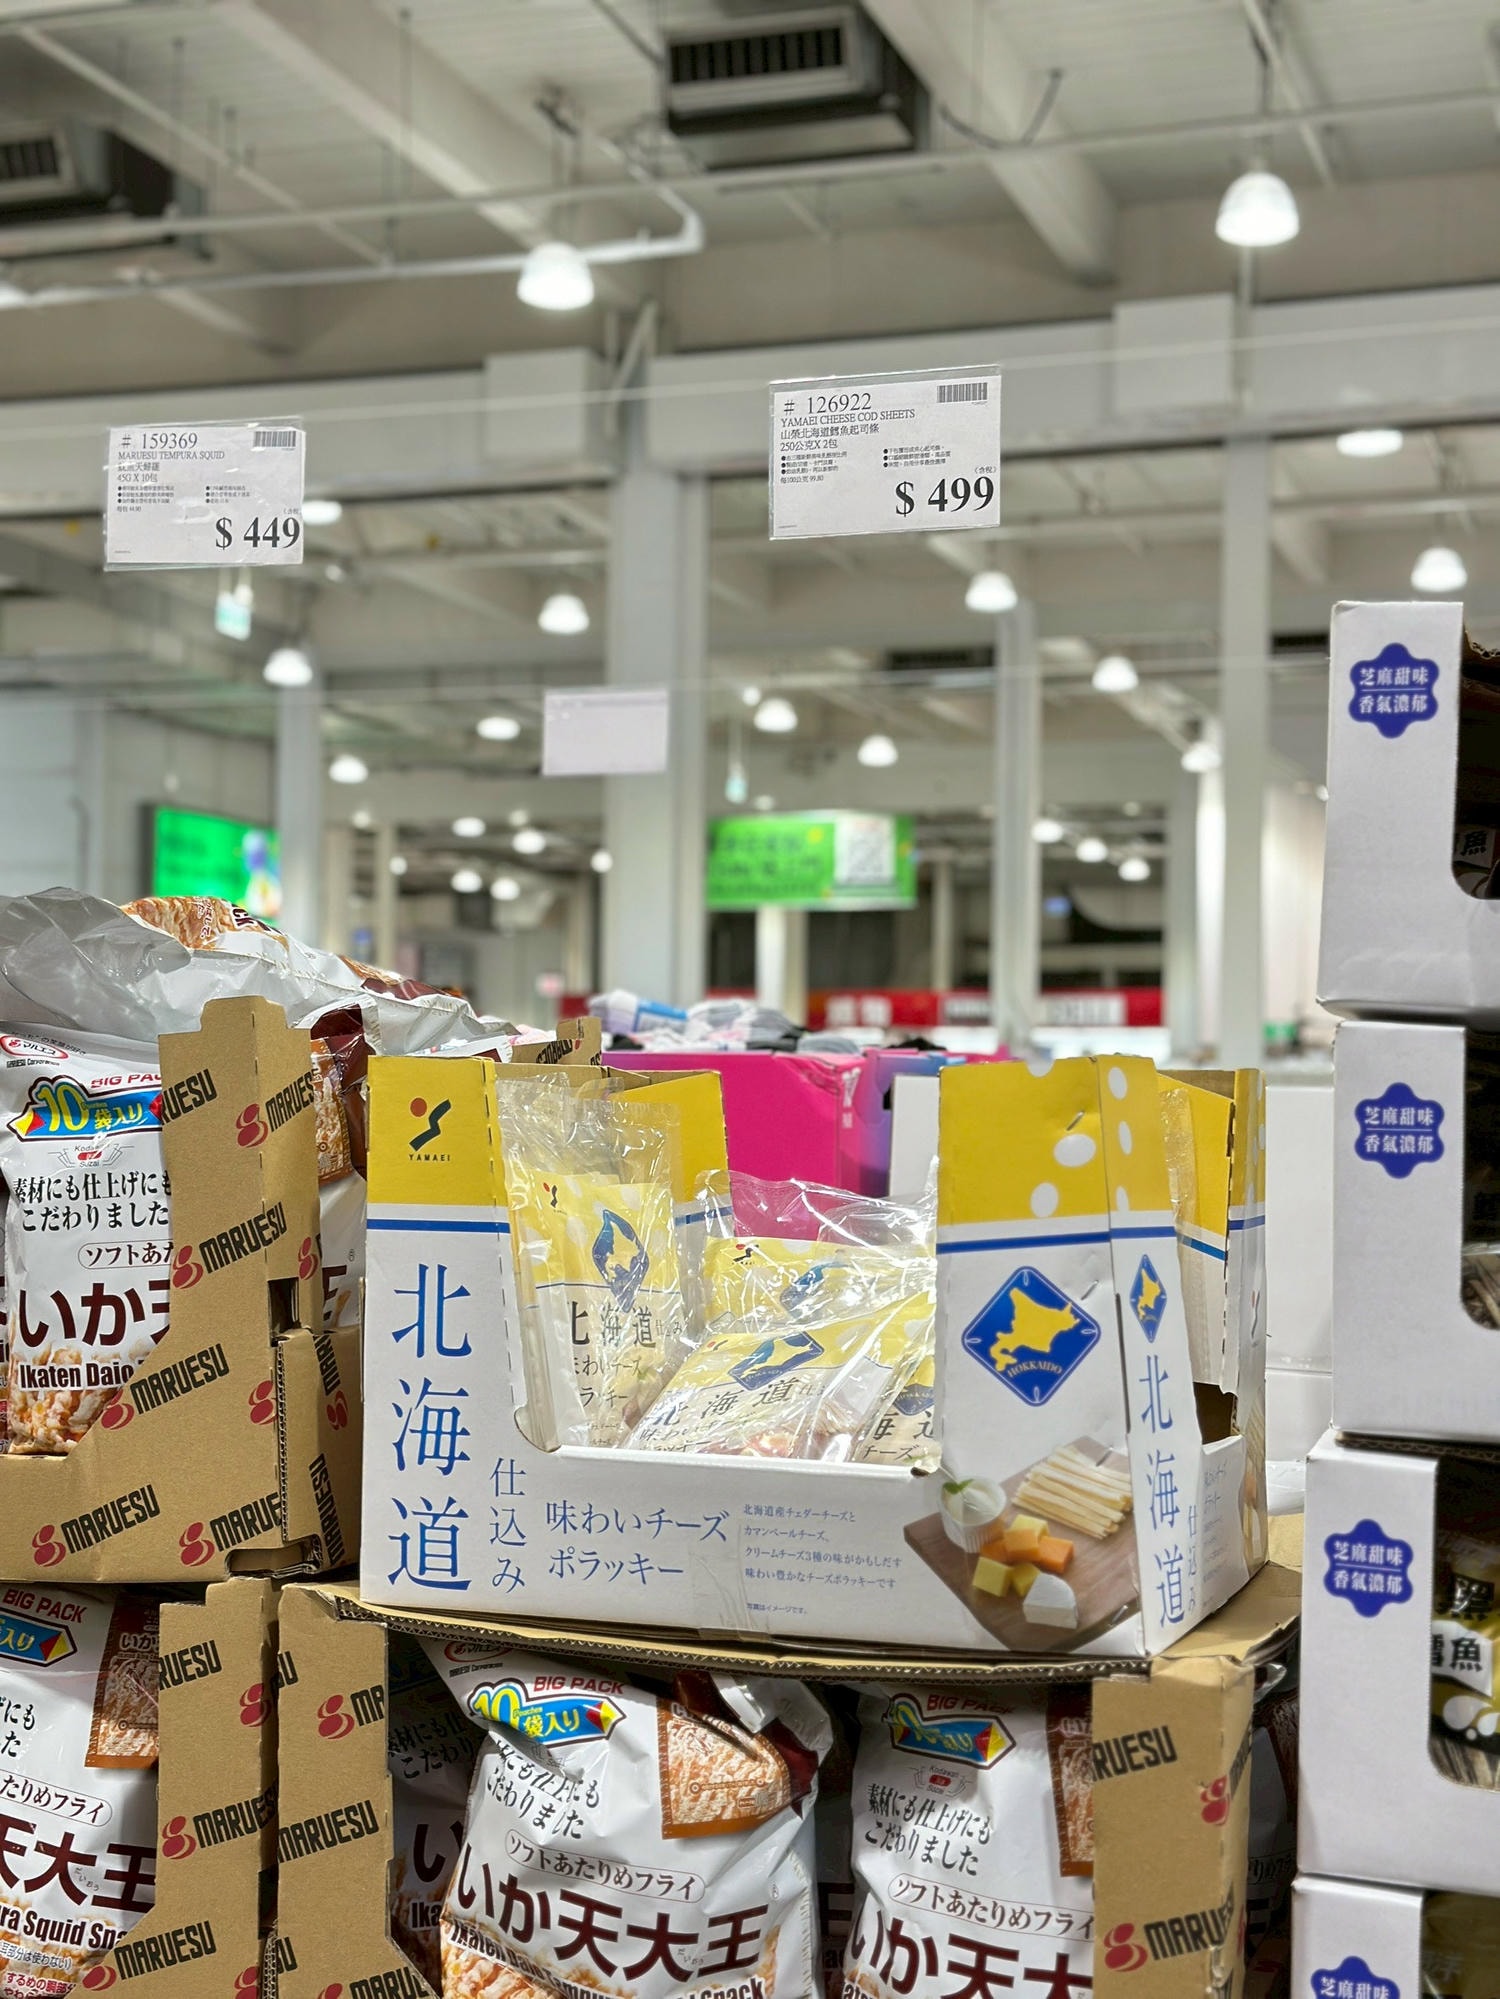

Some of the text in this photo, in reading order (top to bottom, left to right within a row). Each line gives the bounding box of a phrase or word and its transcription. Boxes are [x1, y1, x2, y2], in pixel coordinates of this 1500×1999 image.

[781, 409, 915, 428] YAMAEI CHEESE COD SHEETS
[807, 392, 872, 414] 126922
[118, 451, 225, 461] MARUESU TEMPURA SQUID
[142, 432, 198, 450] 159369
[895, 476, 994, 518] $ 499
[215, 517, 301, 550] $ 449
[1360, 667, 1429, 686] 芝麻甜味
[1359, 694, 1428, 714] 香氣濃郁
[91, 1076, 122, 1089] BIG
[36, 1083, 89, 1131] 10
[1365, 1107, 1434, 1126] 芝麻甜味
[409, 1154, 451, 1162] YAMAEI
[1364, 1135, 1433, 1154] 香氣濃郁
[22, 1202, 169, 1233] こだわりました
[199, 1201, 288, 1274] MARUESU
[20, 1362, 133, 1390] Ikaten Daio
[129, 1343, 230, 1415] MARUESU
[1007, 1360, 1063, 1378] HOKKAIDO
[391, 1264, 472, 1591] 北海道
[1139, 1355, 1185, 1627] 北海道
[61, 1484, 161, 1554] MARUESU
[489, 1458, 527, 1593] 仕込み
[546, 1499, 730, 1542] 味わいチーズ
[744, 1504, 856, 1522] 北海道産チェダーチーズと
[549, 1546, 683, 1585] ポラッキー
[1333, 1540, 1403, 1566] 芝麻甜味
[1333, 1570, 1403, 1595] 香氣濃郁
[5, 1589, 87, 1624] BIG PACK
[0, 1619, 35, 1651] 入り
[534, 1676, 625, 1694] BIG PACK
[473, 1687, 580, 1738] 10 袋入り
[927, 1695, 956, 1712] BIG
[867, 1783, 992, 1845] 素材にも仕上げにも
[278, 1800, 379, 1863] MARUESU
[865, 1821, 979, 1876] こだわりました
[509, 1836, 696, 1902] ソフトあたりめフライ
[457, 1842, 770, 1984] いか天大王
[896, 1879, 1093, 1940] ソフトあたりめフライ
[23, 1910, 87, 1946] Squid
[114, 1919, 217, 1980] MARUESU
[1321, 1976, 1391, 1999] 芝麻甜味
